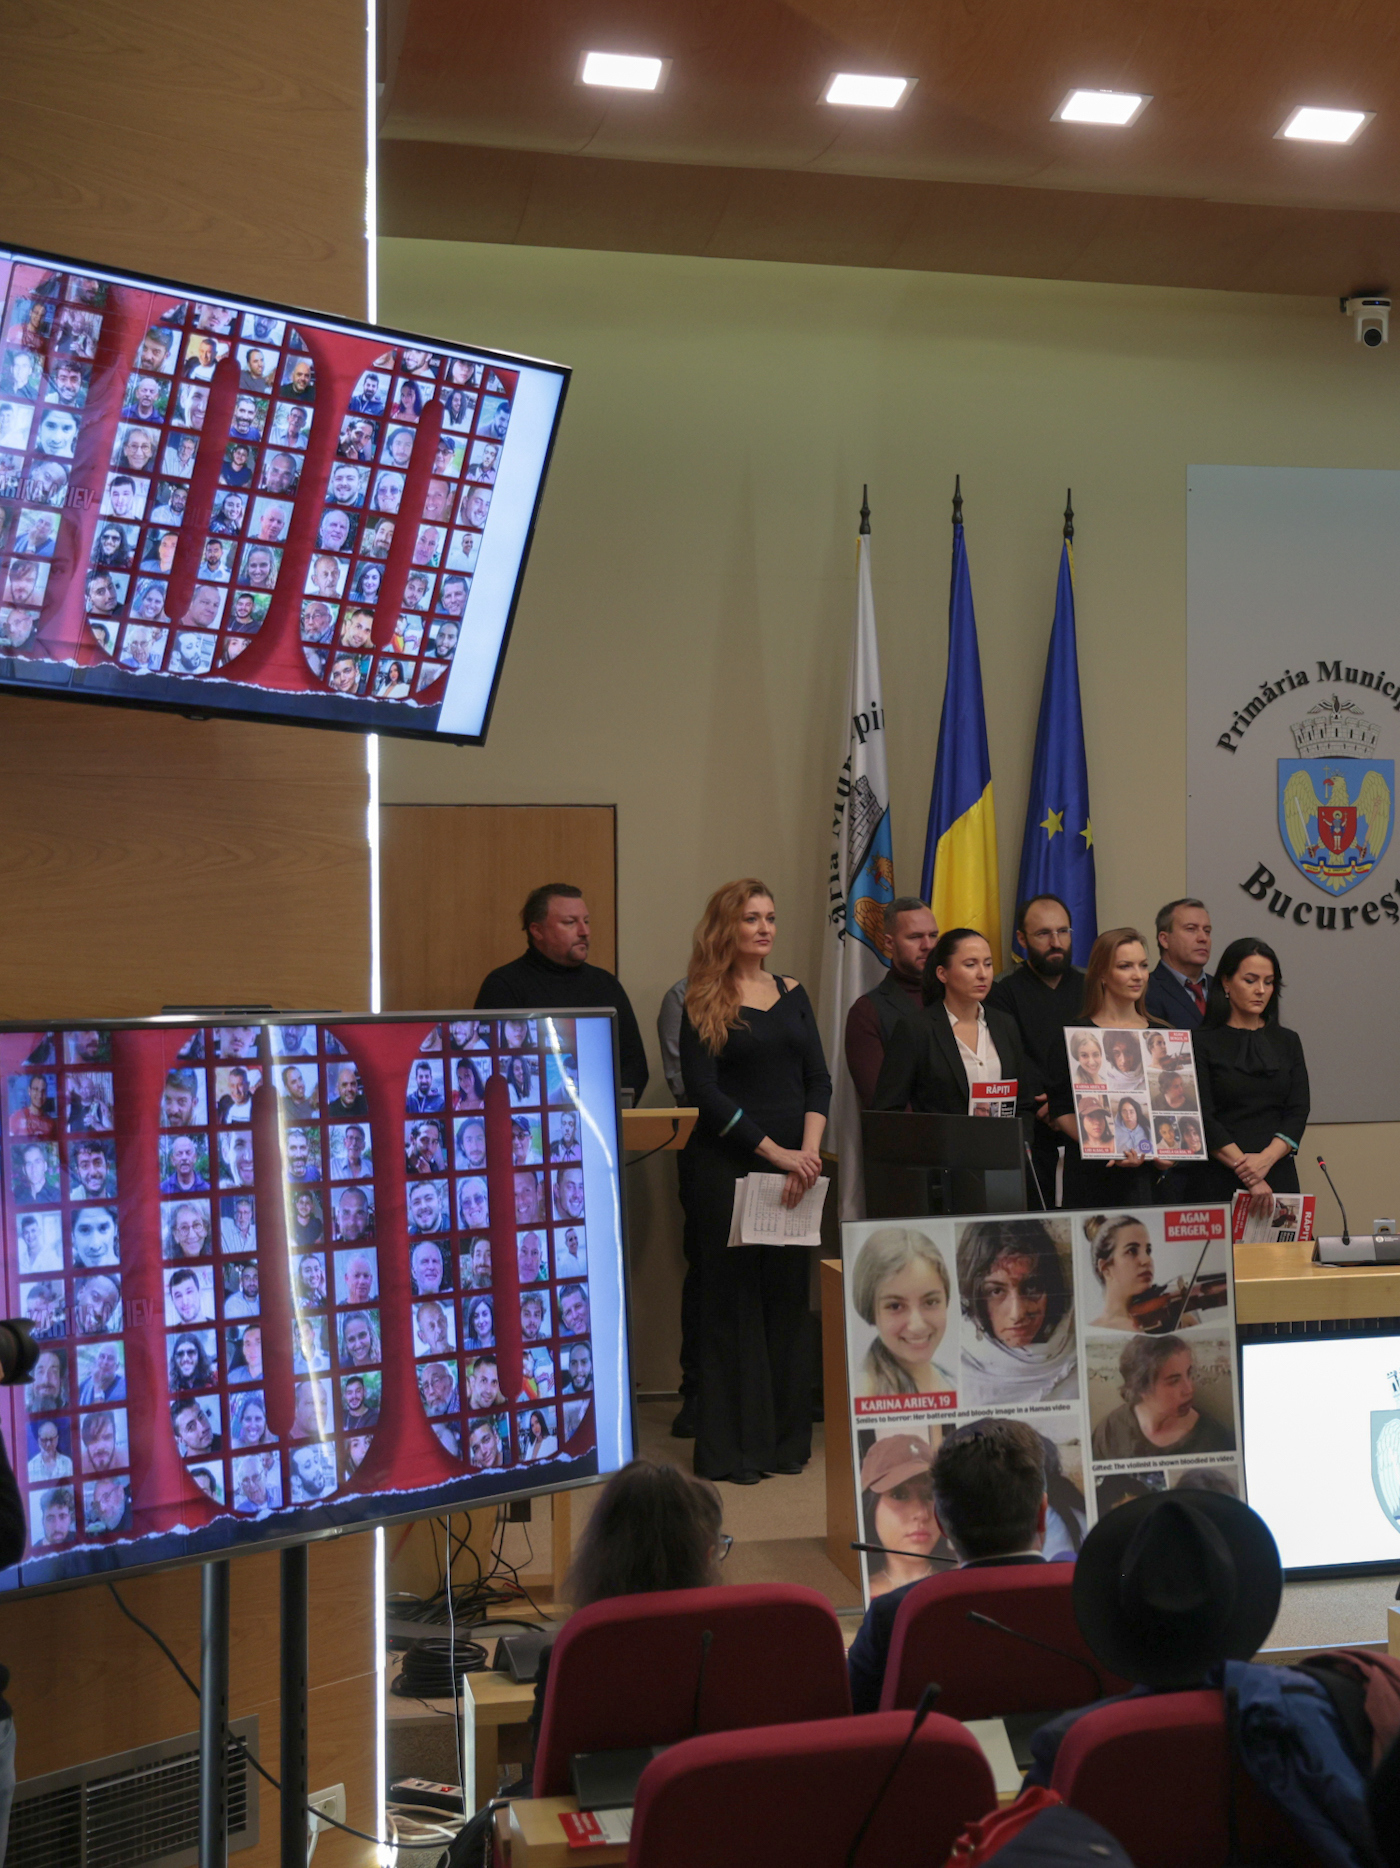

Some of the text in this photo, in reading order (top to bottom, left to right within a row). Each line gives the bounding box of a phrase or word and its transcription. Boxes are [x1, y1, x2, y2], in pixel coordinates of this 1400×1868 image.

[1215, 668, 1310, 755] Primăria
[853, 701, 885, 745] pi
[1179, 1211, 1210, 1224] AGAM
[1168, 1223, 1222, 1237] BERGER, 19
[860, 1395, 951, 1412] KARINA ARIEV, 19
[856, 1417, 878, 1425] Smiles
[926, 1411, 956, 1419] battered
[970, 1408, 994, 1417] bloody
[995, 1407, 1016, 1416] image
[1029, 1405, 1052, 1413] Hamas
[1052, 1403, 1071, 1411] video
[1092, 1463, 1113, 1471] Gifted:
[1113, 1462, 1126, 1470] The
[1127, 1461, 1151, 1469] violinist
[1159, 1459, 1179, 1467] shown
[1180, 1457, 1209, 1465] bloodied
